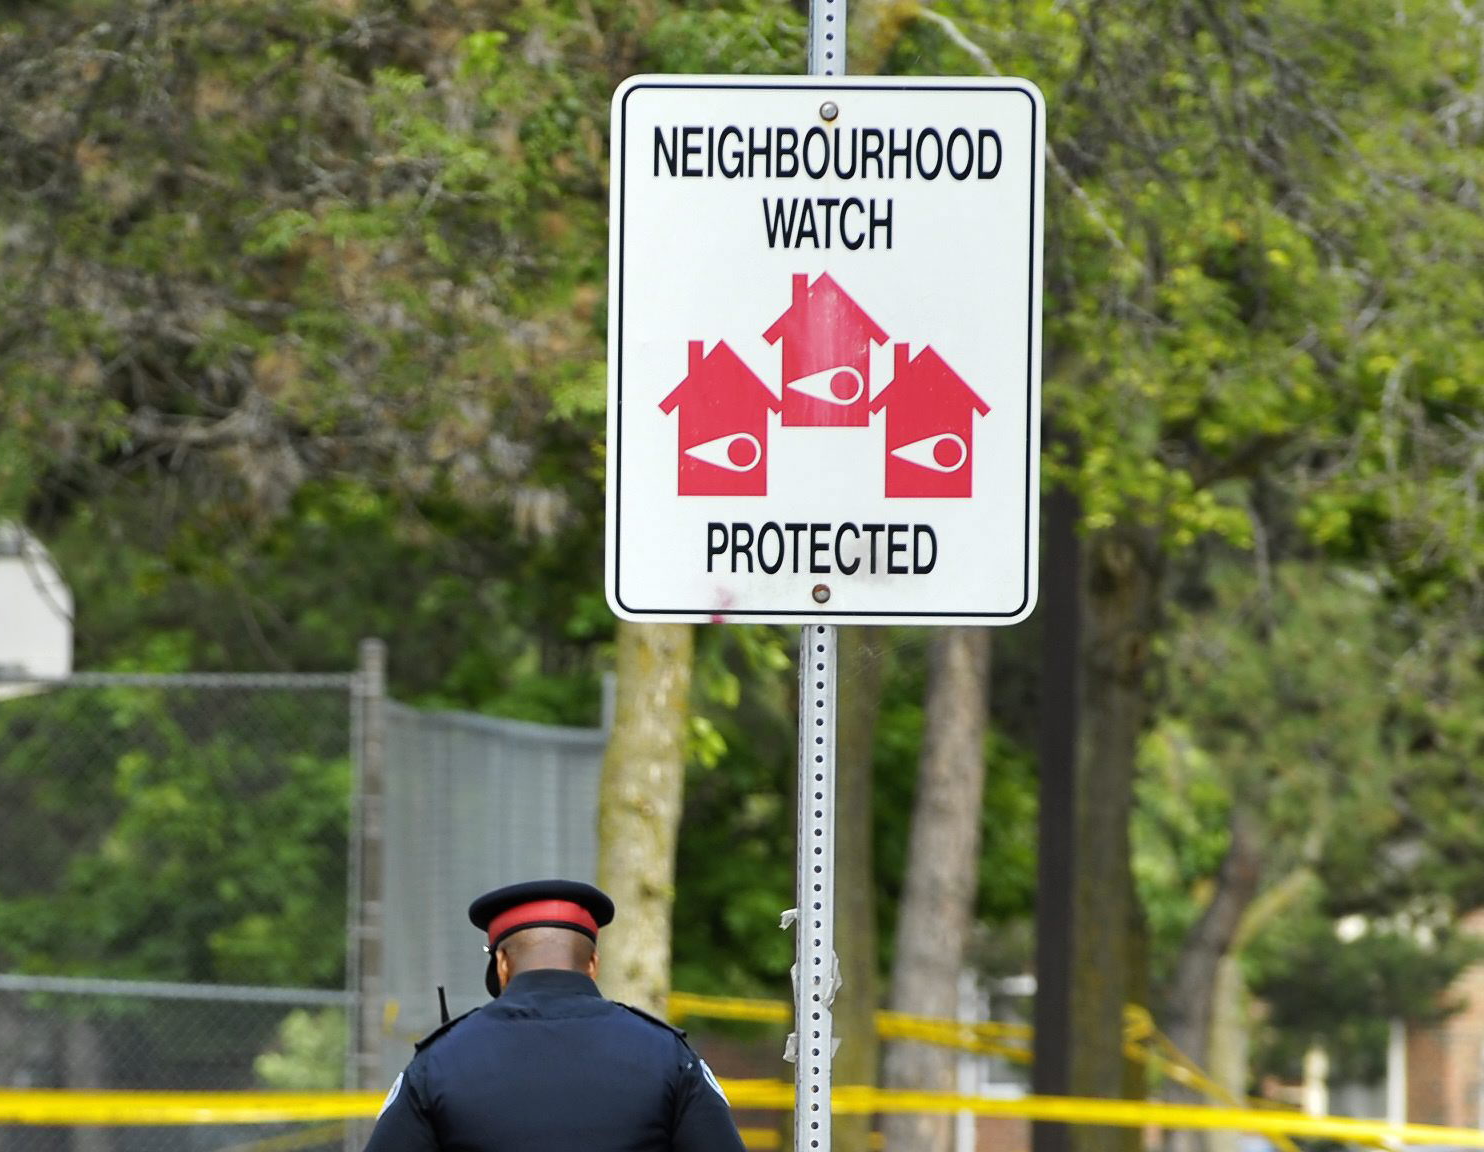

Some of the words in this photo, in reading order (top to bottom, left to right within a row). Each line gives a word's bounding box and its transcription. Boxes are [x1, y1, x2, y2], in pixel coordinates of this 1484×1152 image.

[653, 126, 1003, 181] NEIGHBOURHOOD
[762, 197, 893, 250] WATCH
[706, 521, 938, 576] PROTECTED
